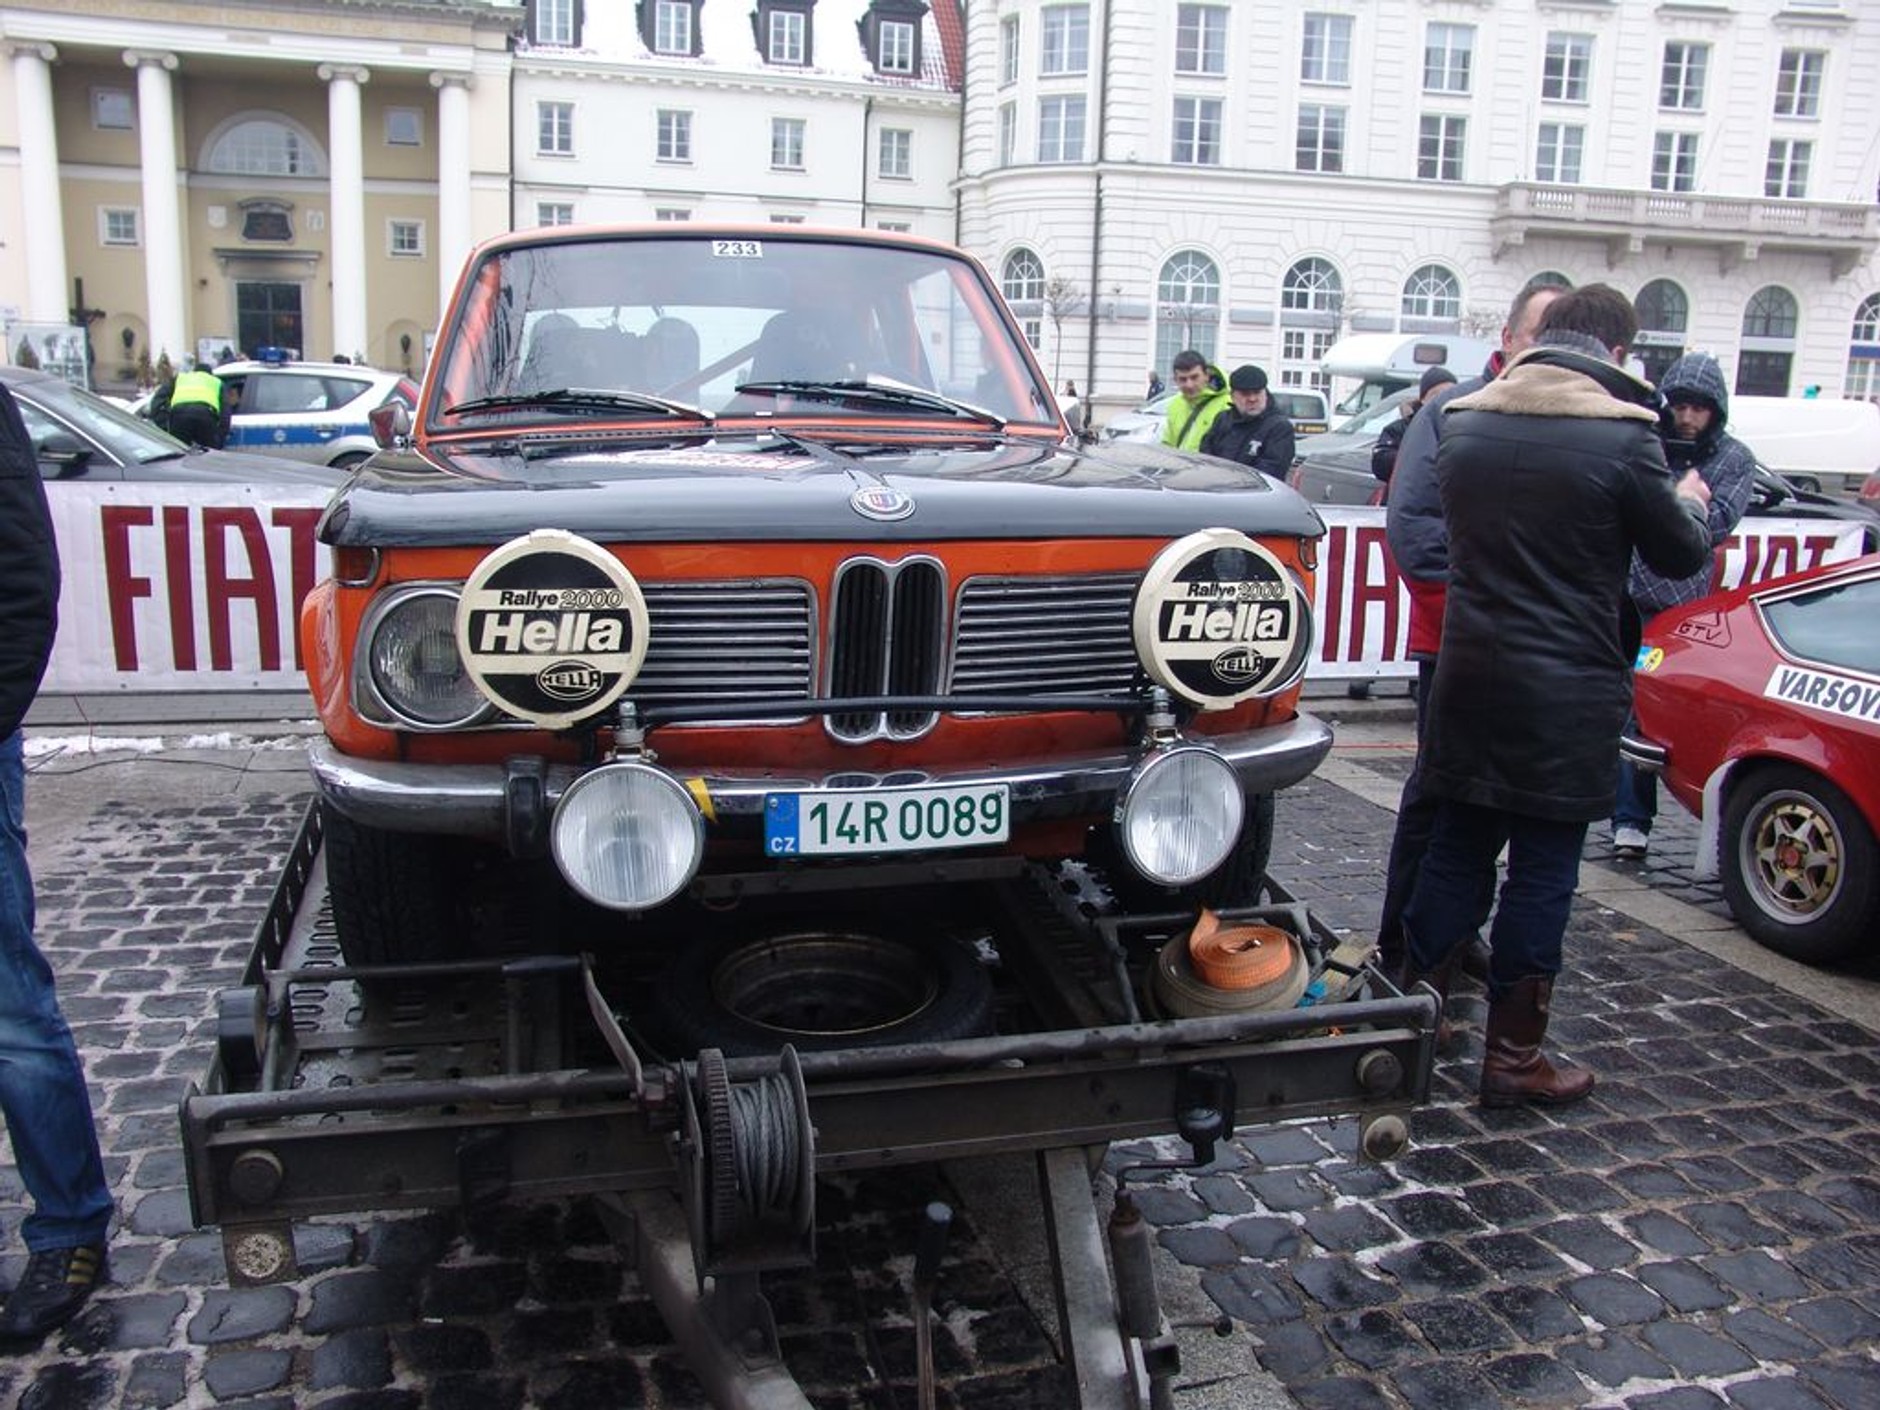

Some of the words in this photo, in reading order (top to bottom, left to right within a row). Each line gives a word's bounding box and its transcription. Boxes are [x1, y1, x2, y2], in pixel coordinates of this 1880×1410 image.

[718, 242, 758, 255] 233
[100, 505, 323, 671] FIAT
[1187, 583, 1235, 598] Rallye
[1322, 526, 1413, 662] IA
[500, 591, 559, 608] Rallye
[560, 588, 623, 609] 2000
[1167, 603, 1283, 640] Hella
[1679, 622, 1721, 640] GTV
[480, 612, 623, 652] Hella
[1214, 654, 1263, 672] HELLA
[541, 670, 602, 688] HELLA
[809, 801, 889, 845] 14R
[899, 793, 1001, 841] 0089
[771, 837, 795, 852] CZ
